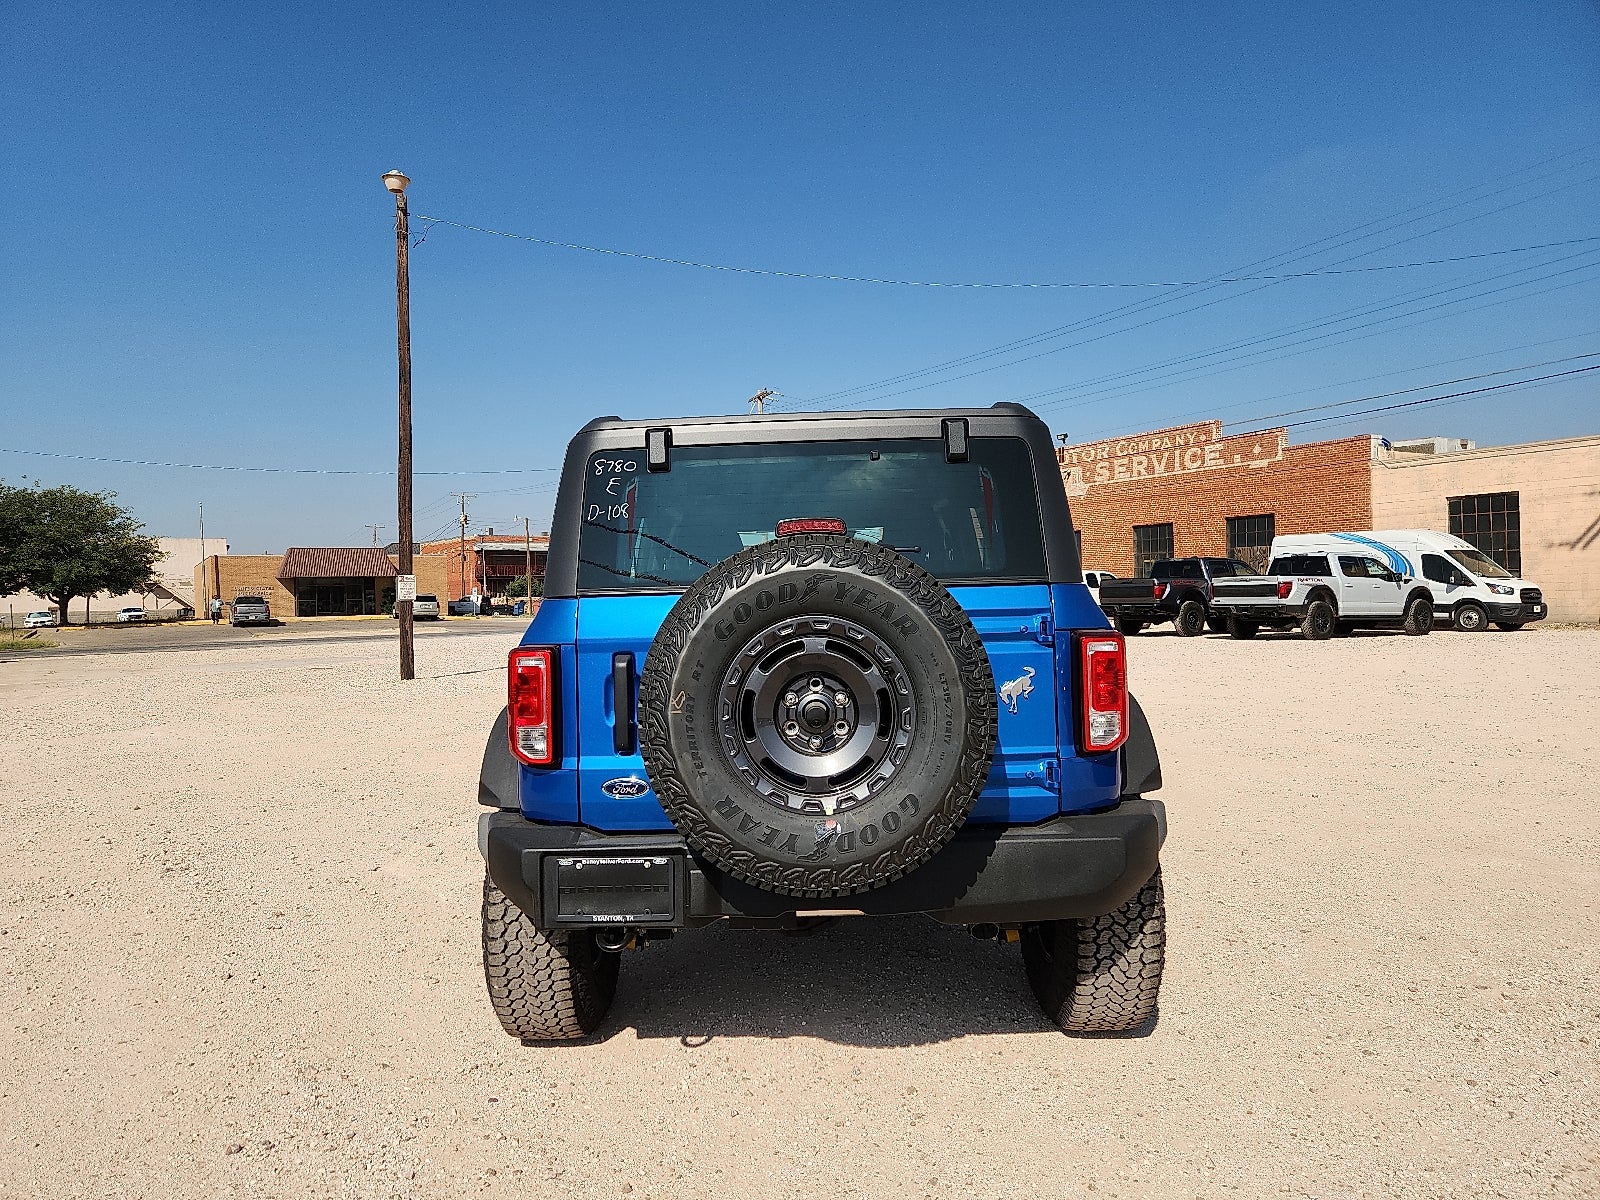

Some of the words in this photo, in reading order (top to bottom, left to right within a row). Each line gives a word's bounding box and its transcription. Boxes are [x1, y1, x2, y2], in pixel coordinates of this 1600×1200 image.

[594, 459, 637, 475] 8780
[1094, 443, 1226, 482] SERVICE
[605, 477, 621, 495] E
[587, 502, 630, 520] D-108
[684, 693, 708, 778] TERRITORY
[612, 782, 639, 794] Ford
